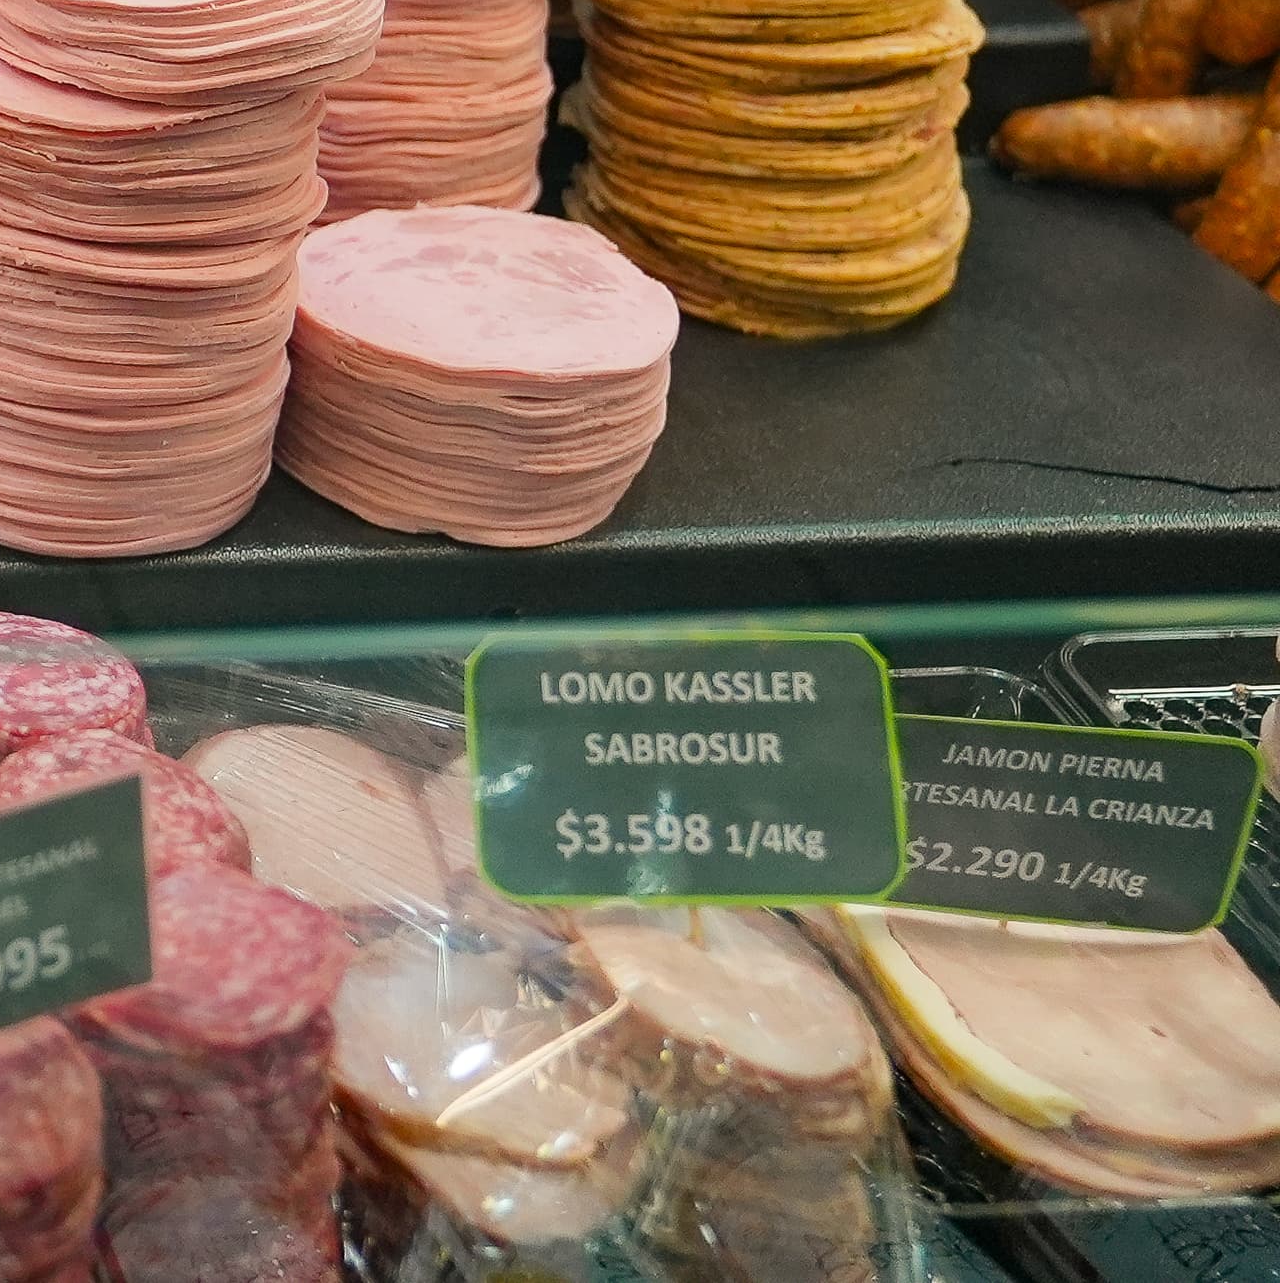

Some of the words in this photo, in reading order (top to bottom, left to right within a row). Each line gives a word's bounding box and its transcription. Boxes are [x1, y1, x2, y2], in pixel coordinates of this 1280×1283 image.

[539, 671, 656, 704] LOMO
[663, 670, 819, 704] KASSLER
[583, 731, 785, 766] SABROSUR
[942, 741, 1053, 774] JAMON
[1058, 751, 1166, 784] PIERNA
[1043, 793, 1080, 819] LA
[1086, 797, 1216, 832] CRIANZA
[555, 808, 714, 862] $3.598
[724, 820, 830, 862] 1/4Kg
[905, 835, 1046, 883] $2.290
[1053, 860, 1150, 899] 1/4Kg
